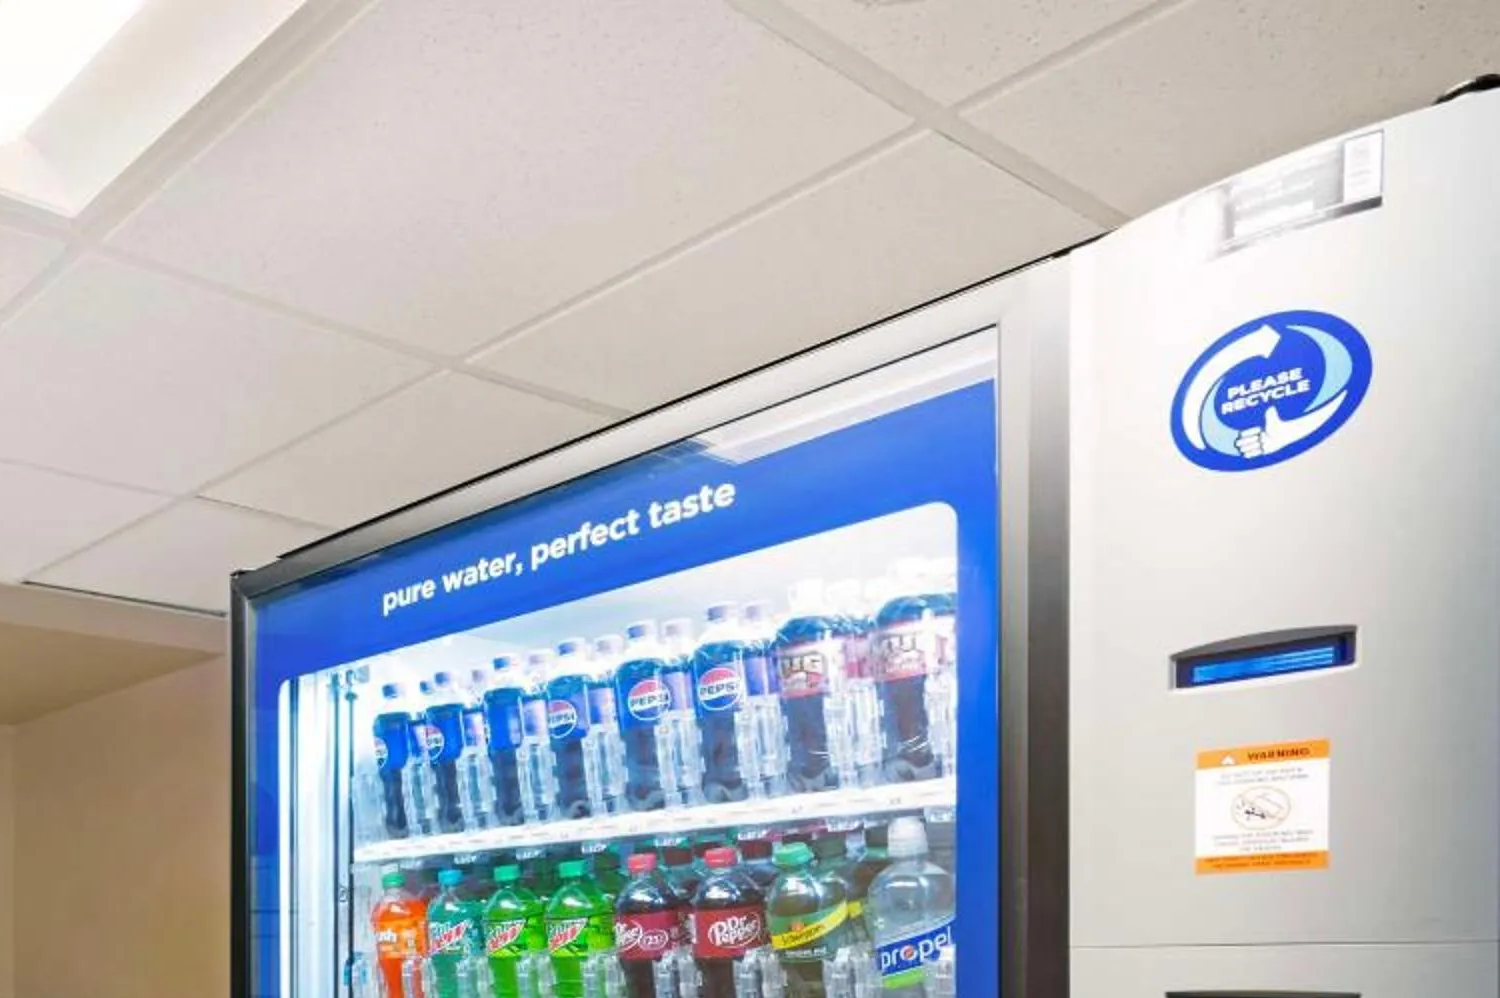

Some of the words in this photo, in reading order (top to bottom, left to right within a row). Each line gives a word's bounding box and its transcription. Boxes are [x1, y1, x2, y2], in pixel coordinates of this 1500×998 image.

[1221, 379, 1311, 415] RECYCLE
[1227, 368, 1303, 399] PLEASE
[381, 576, 436, 617] pure
[443, 549, 524, 593] water,
[530, 507, 641, 571] perfect
[648, 481, 736, 529] taste
[1247, 747, 1310, 762] WARNING
[881, 924, 952, 973] propel
